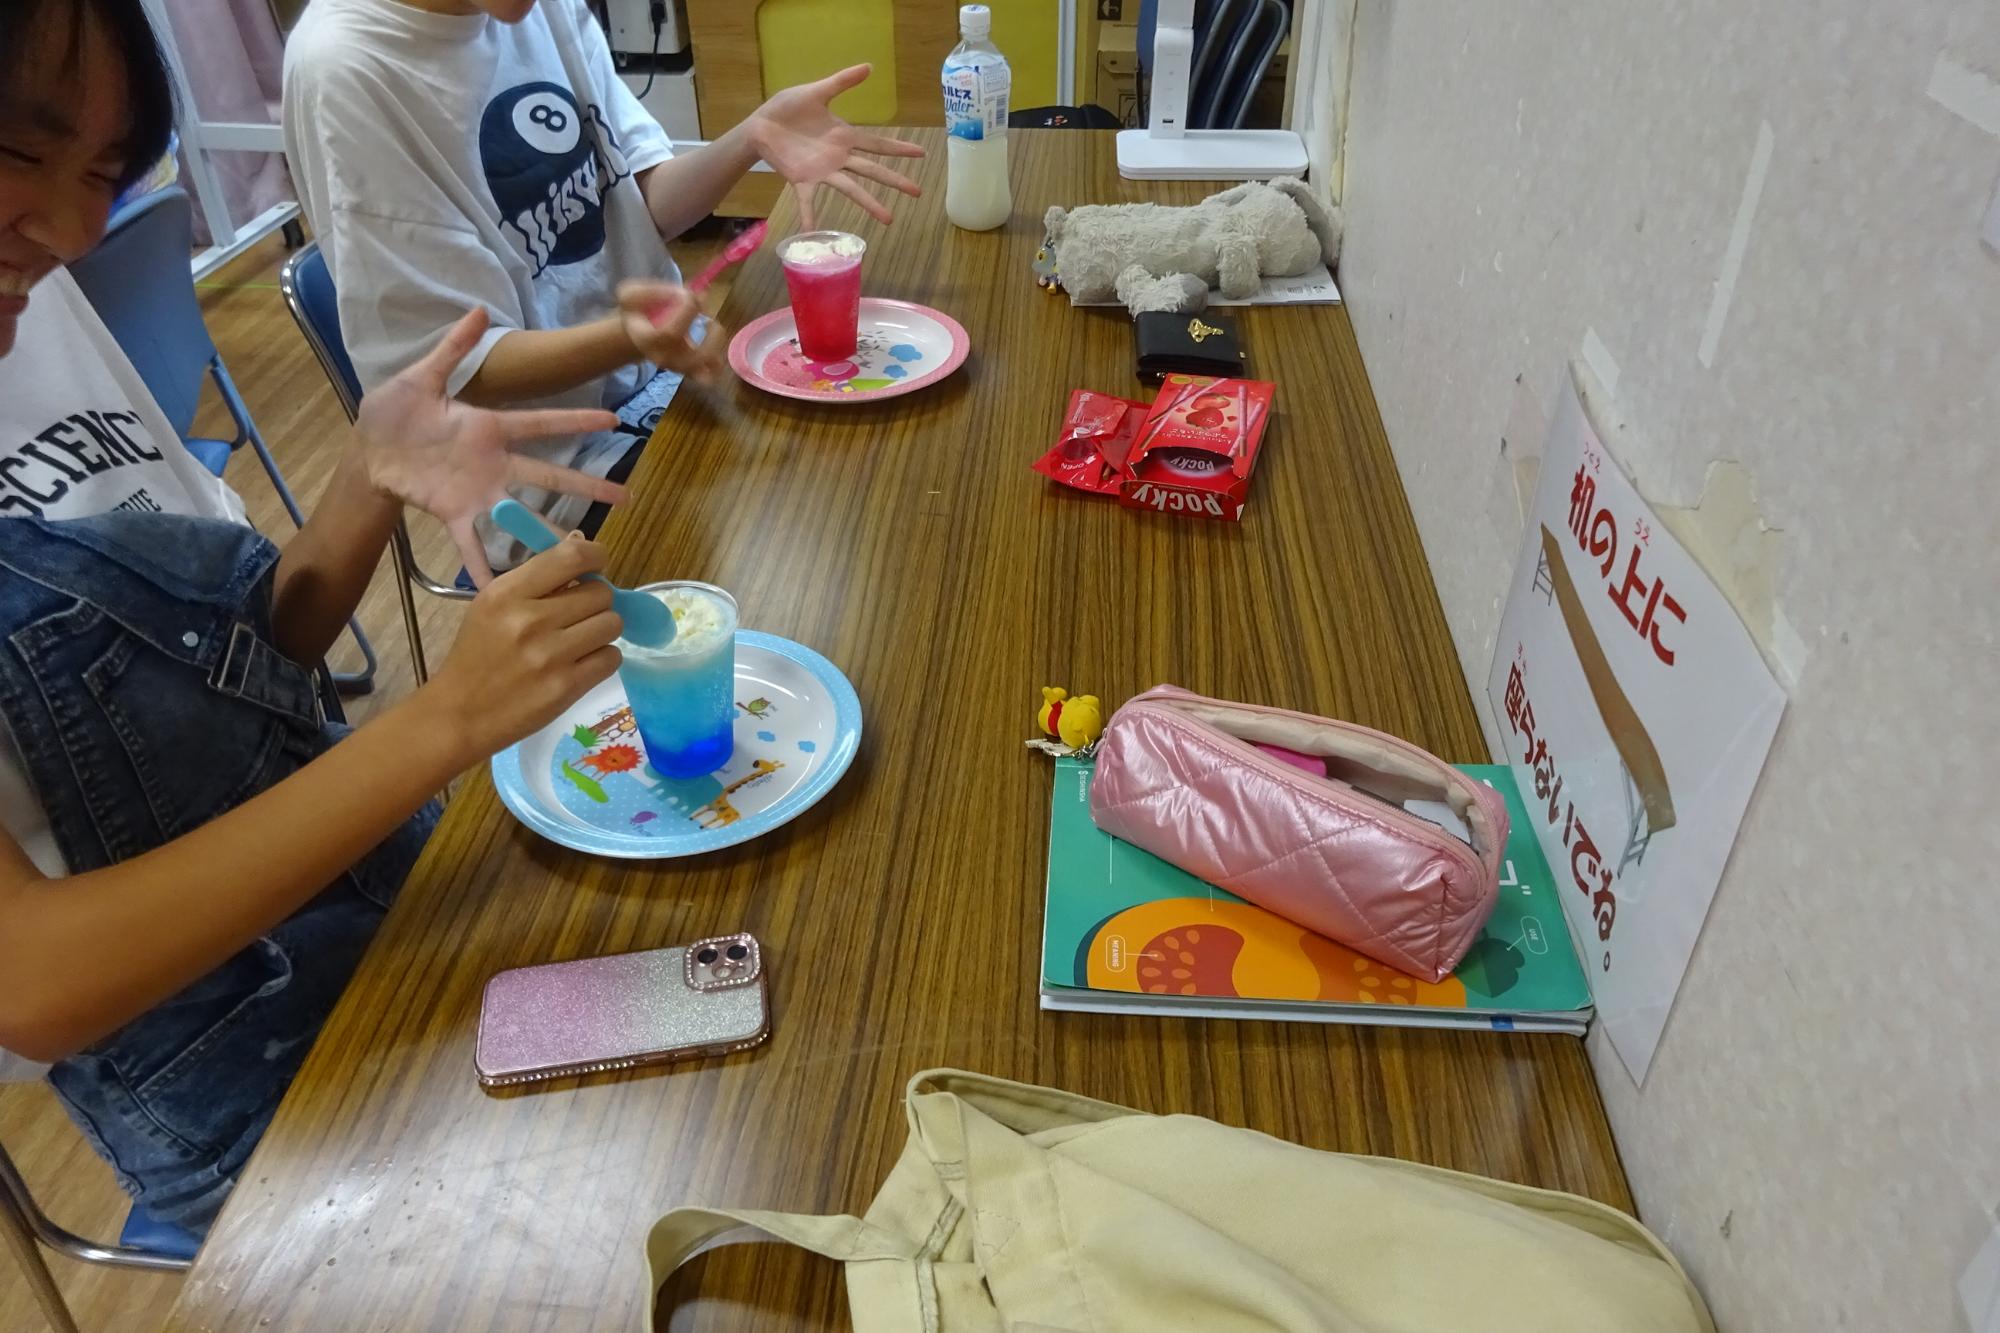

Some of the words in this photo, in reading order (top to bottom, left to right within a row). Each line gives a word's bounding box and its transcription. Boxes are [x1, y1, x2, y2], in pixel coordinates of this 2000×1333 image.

[529, 104, 568, 133] 8
[0, 410, 164, 520] SCIENC
[1060, 462, 1085, 471] OPEN
[1567, 463, 1688, 667] 机の上に
[1528, 928, 1539, 941] USE
[1111, 939, 1120, 967] MEANING
